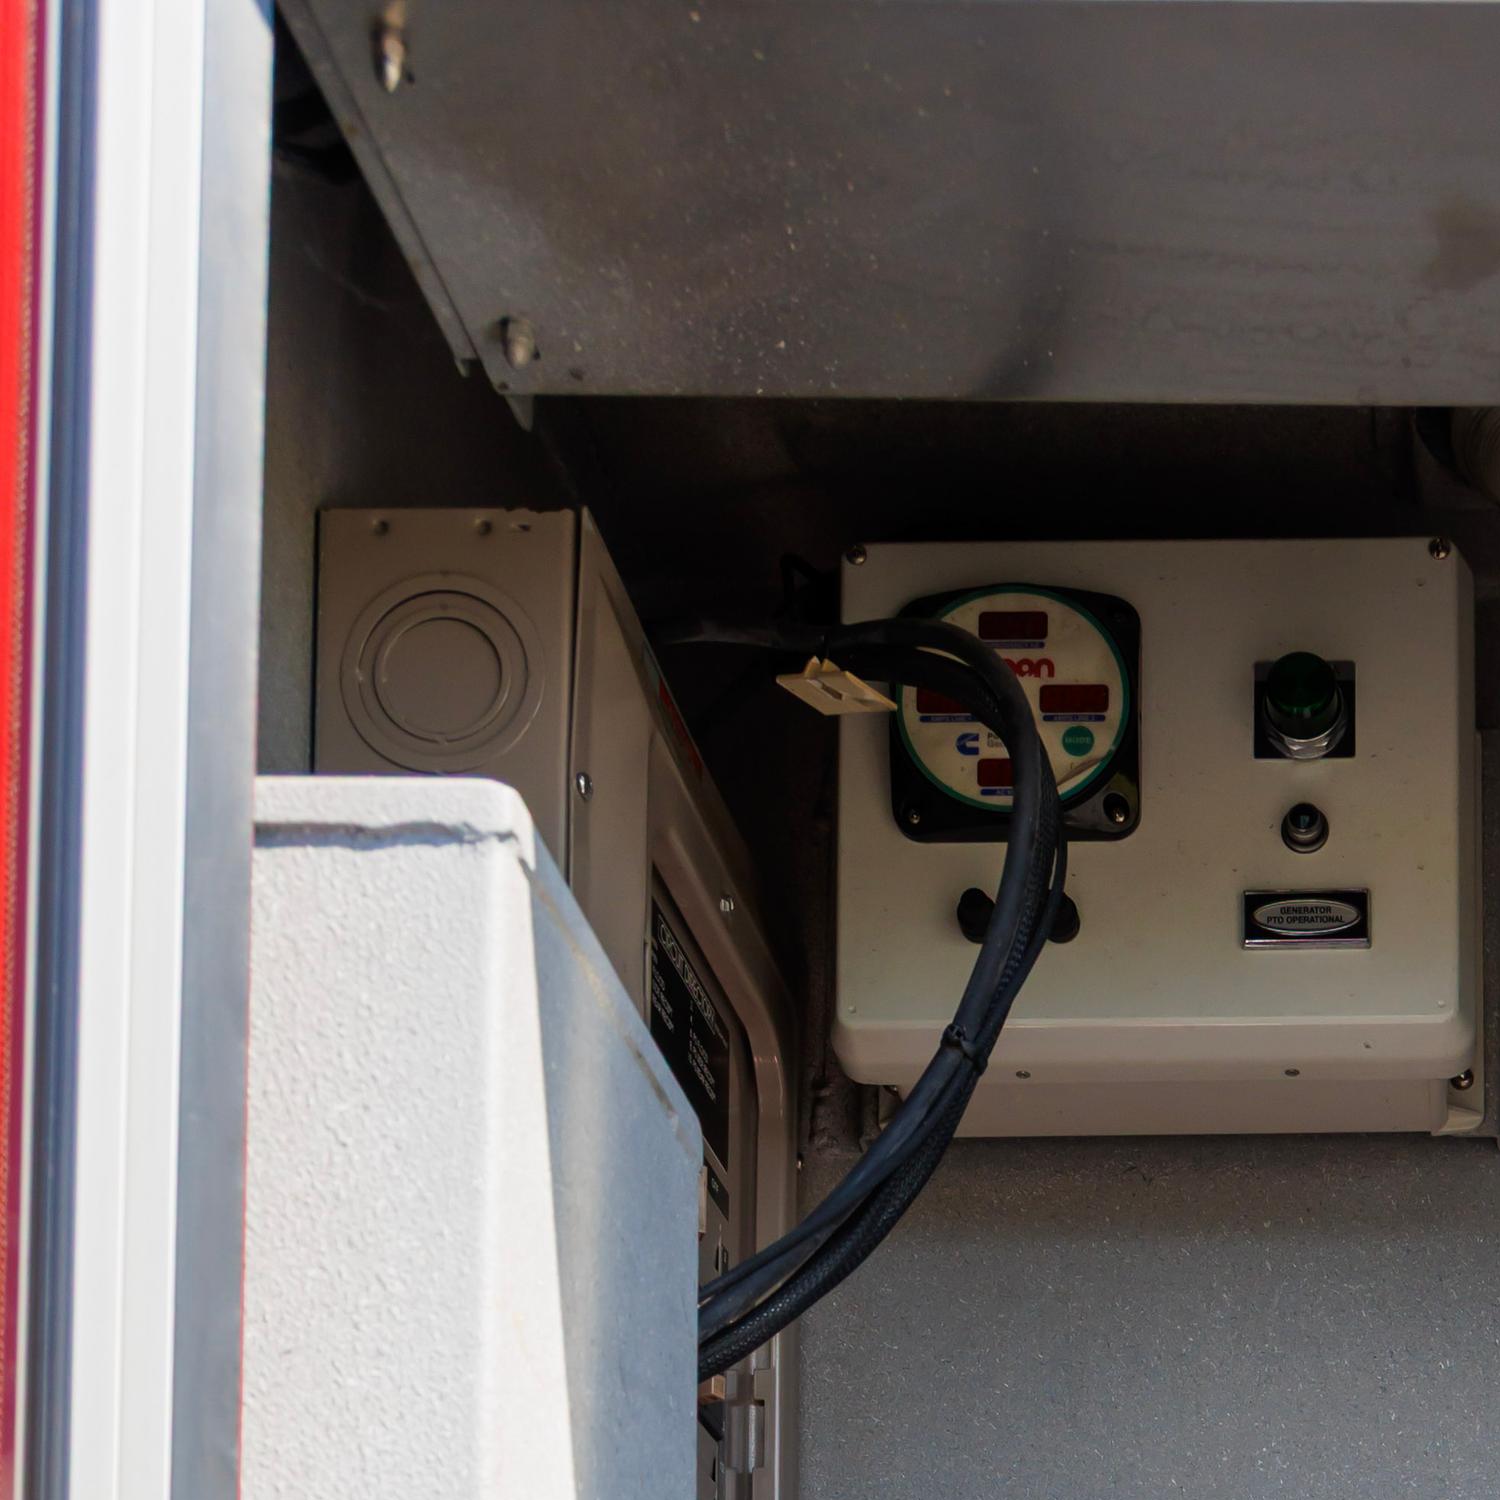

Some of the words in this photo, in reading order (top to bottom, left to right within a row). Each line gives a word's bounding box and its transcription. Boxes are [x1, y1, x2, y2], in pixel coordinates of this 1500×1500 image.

[1280, 906, 1332, 915] GENERATOR
[1266, 915, 1285, 924] PTO
[1286, 914, 1344, 924] OPERATIONAL
